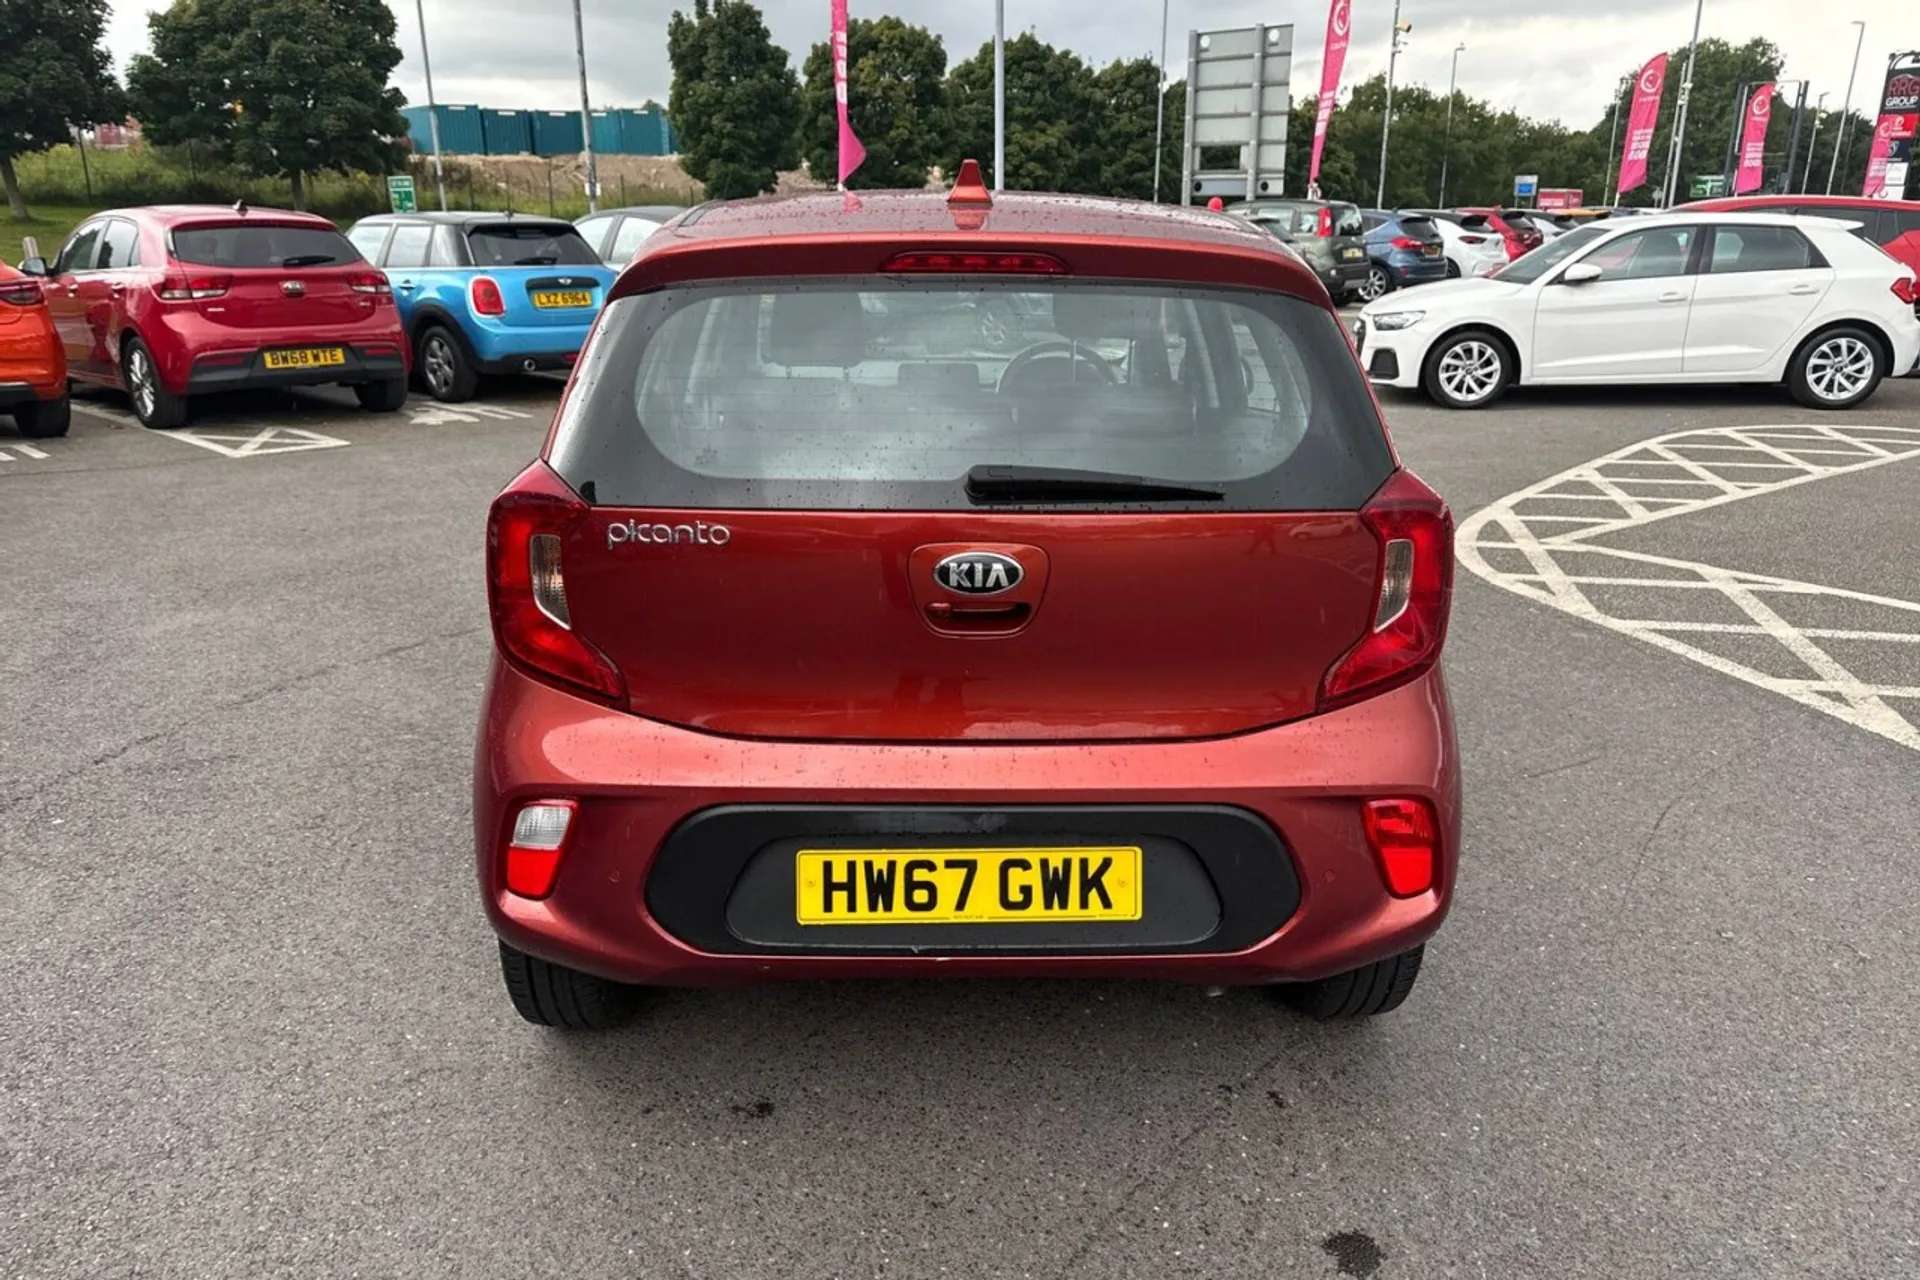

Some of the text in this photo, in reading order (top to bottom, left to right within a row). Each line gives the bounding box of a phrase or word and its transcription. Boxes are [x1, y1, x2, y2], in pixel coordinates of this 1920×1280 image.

[1888, 78, 1920, 96] RRG
[1885, 95, 1919, 107] GROUP
[536, 292, 560, 306] LXZ
[270, 351, 309, 366] BW68
[608, 518, 731, 550] picanto
[948, 562, 1009, 588] KIA
[822, 857, 1113, 913] HW67 GWK
